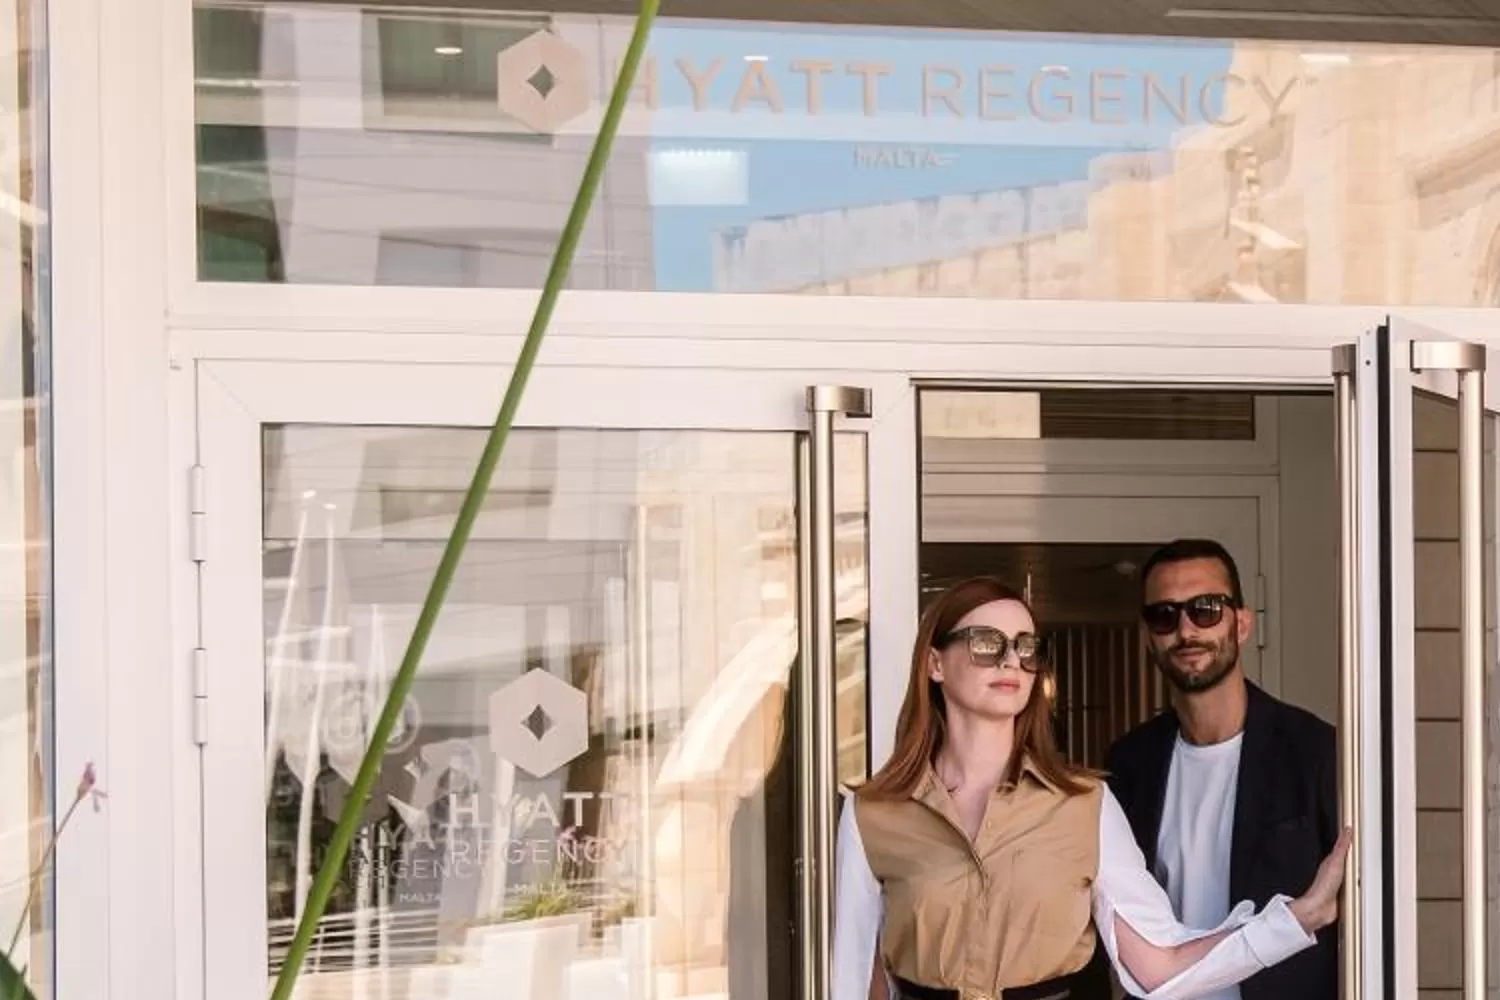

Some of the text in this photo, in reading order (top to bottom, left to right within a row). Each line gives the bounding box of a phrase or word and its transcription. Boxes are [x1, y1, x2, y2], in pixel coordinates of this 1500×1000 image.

[612, 54, 1300, 129] HYATT REGENCY
[449, 791, 632, 828] HYATT
